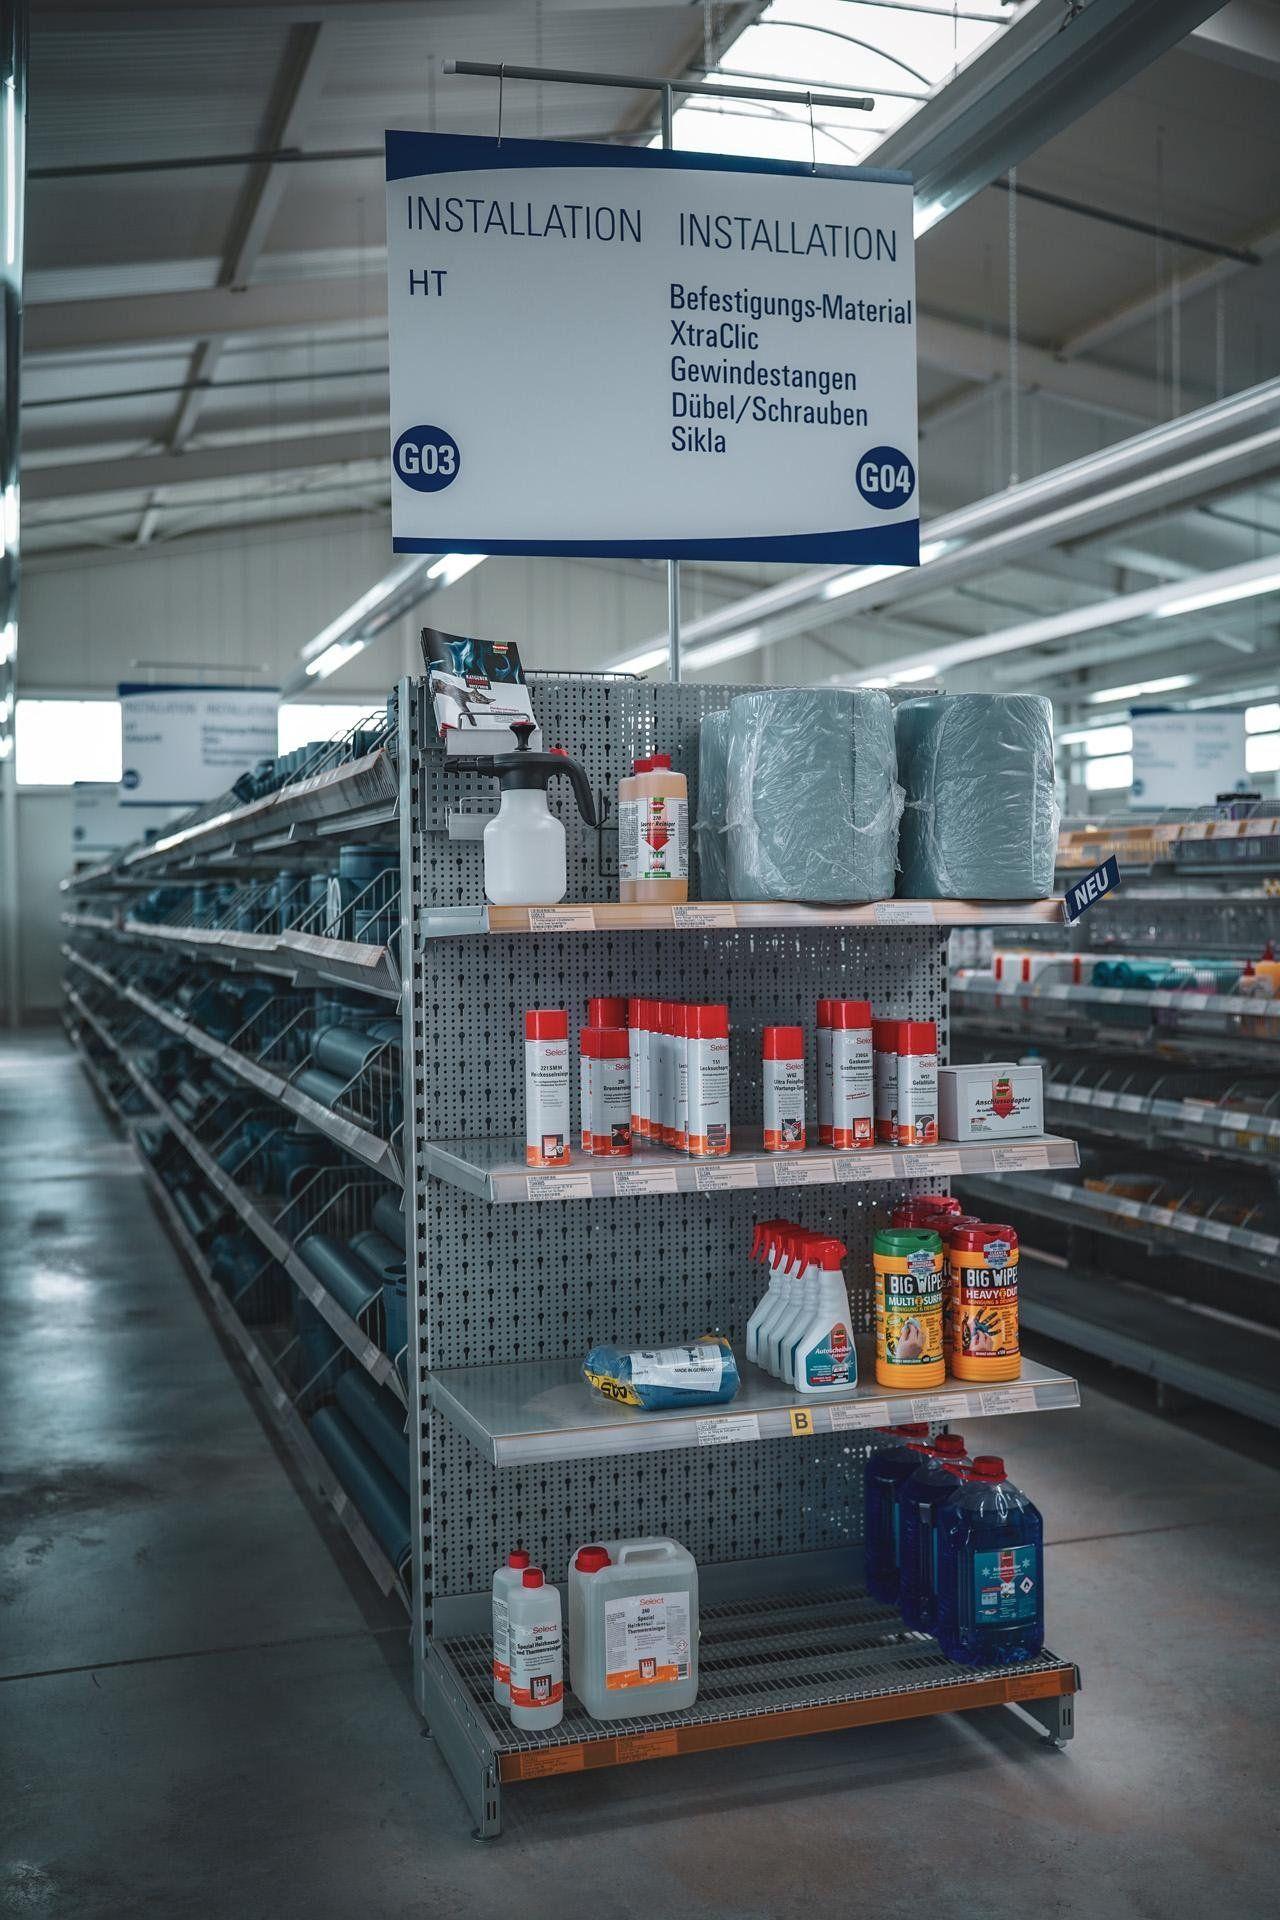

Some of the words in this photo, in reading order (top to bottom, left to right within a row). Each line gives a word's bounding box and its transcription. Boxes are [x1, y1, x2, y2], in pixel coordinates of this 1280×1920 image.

[407, 195, 642, 243] INSTALLATION
[679, 212, 897, 262] INSTALLATION
[409, 269, 448, 297] HT
[670, 283, 912, 324] Befestigungs-Material
[670, 319, 760, 350] XtraClic
[671, 355, 857, 395] Gewindestangen
[672, 391, 868, 427] Dübel/Schrauben
[671, 425, 727, 453] Sikla
[399, 442, 456, 475] G03
[860, 462, 911, 494] G04
[1074, 866, 1109, 911] NEU
[890, 1276, 914, 1294] BIG
[966, 1269, 990, 1288] BIG
[966, 1289, 999, 1299] HEAVY
[888, 1296, 915, 1306] MULTI
[795, 1412, 808, 1430] B
